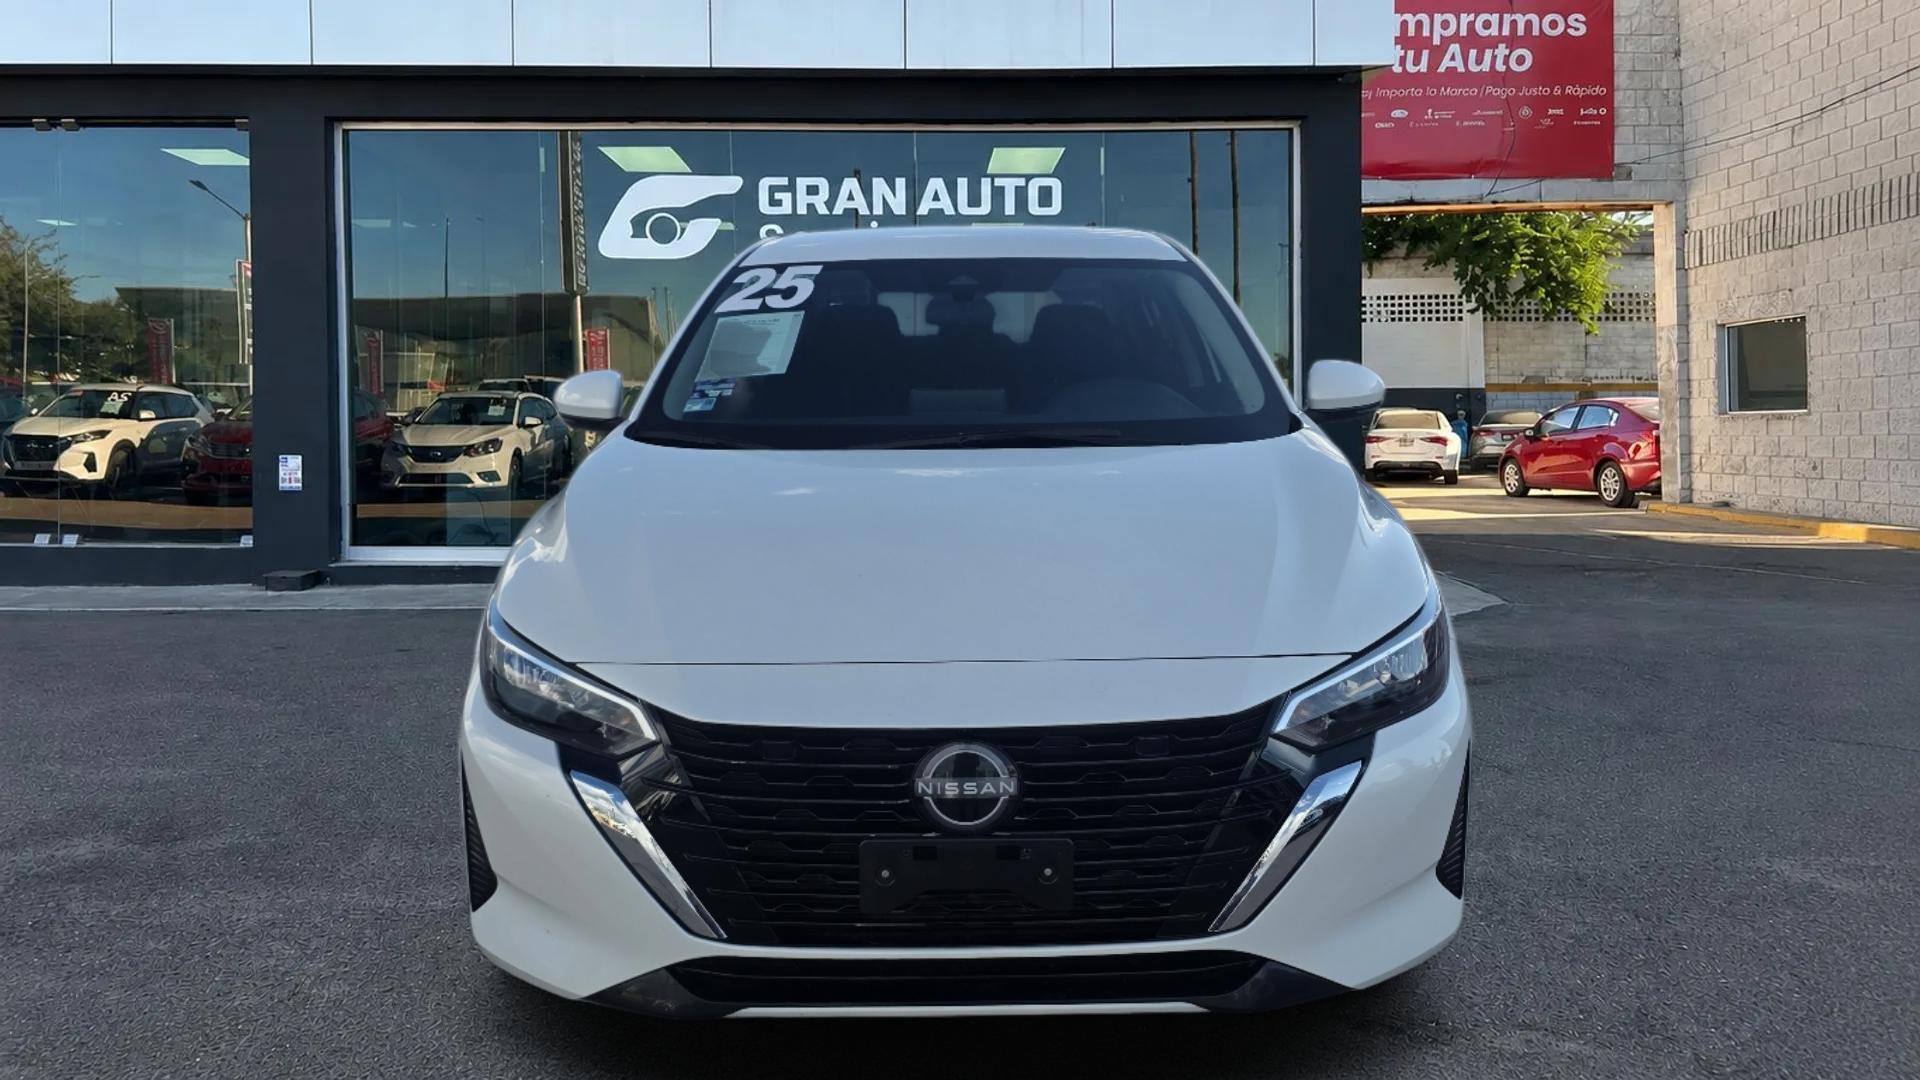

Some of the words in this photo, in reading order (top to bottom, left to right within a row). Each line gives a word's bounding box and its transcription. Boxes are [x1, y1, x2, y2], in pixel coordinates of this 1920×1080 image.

[1392, 44, 1430, 73] tu
[1437, 42, 1534, 73] Auto
[1376, 87, 1423, 99] Importa
[1426, 86, 1437, 97] la
[1440, 86, 1478, 97] Marca
[1518, 86, 1550, 97] Justo
[1553, 85, 1561, 96] &
[1565, 84, 1607, 98] Rápido
[758, 176, 907, 215] GRAN
[916, 176, 1063, 216] AUTO
[714, 264, 823, 313] 25
[917, 781, 1015, 795] NISSAN
